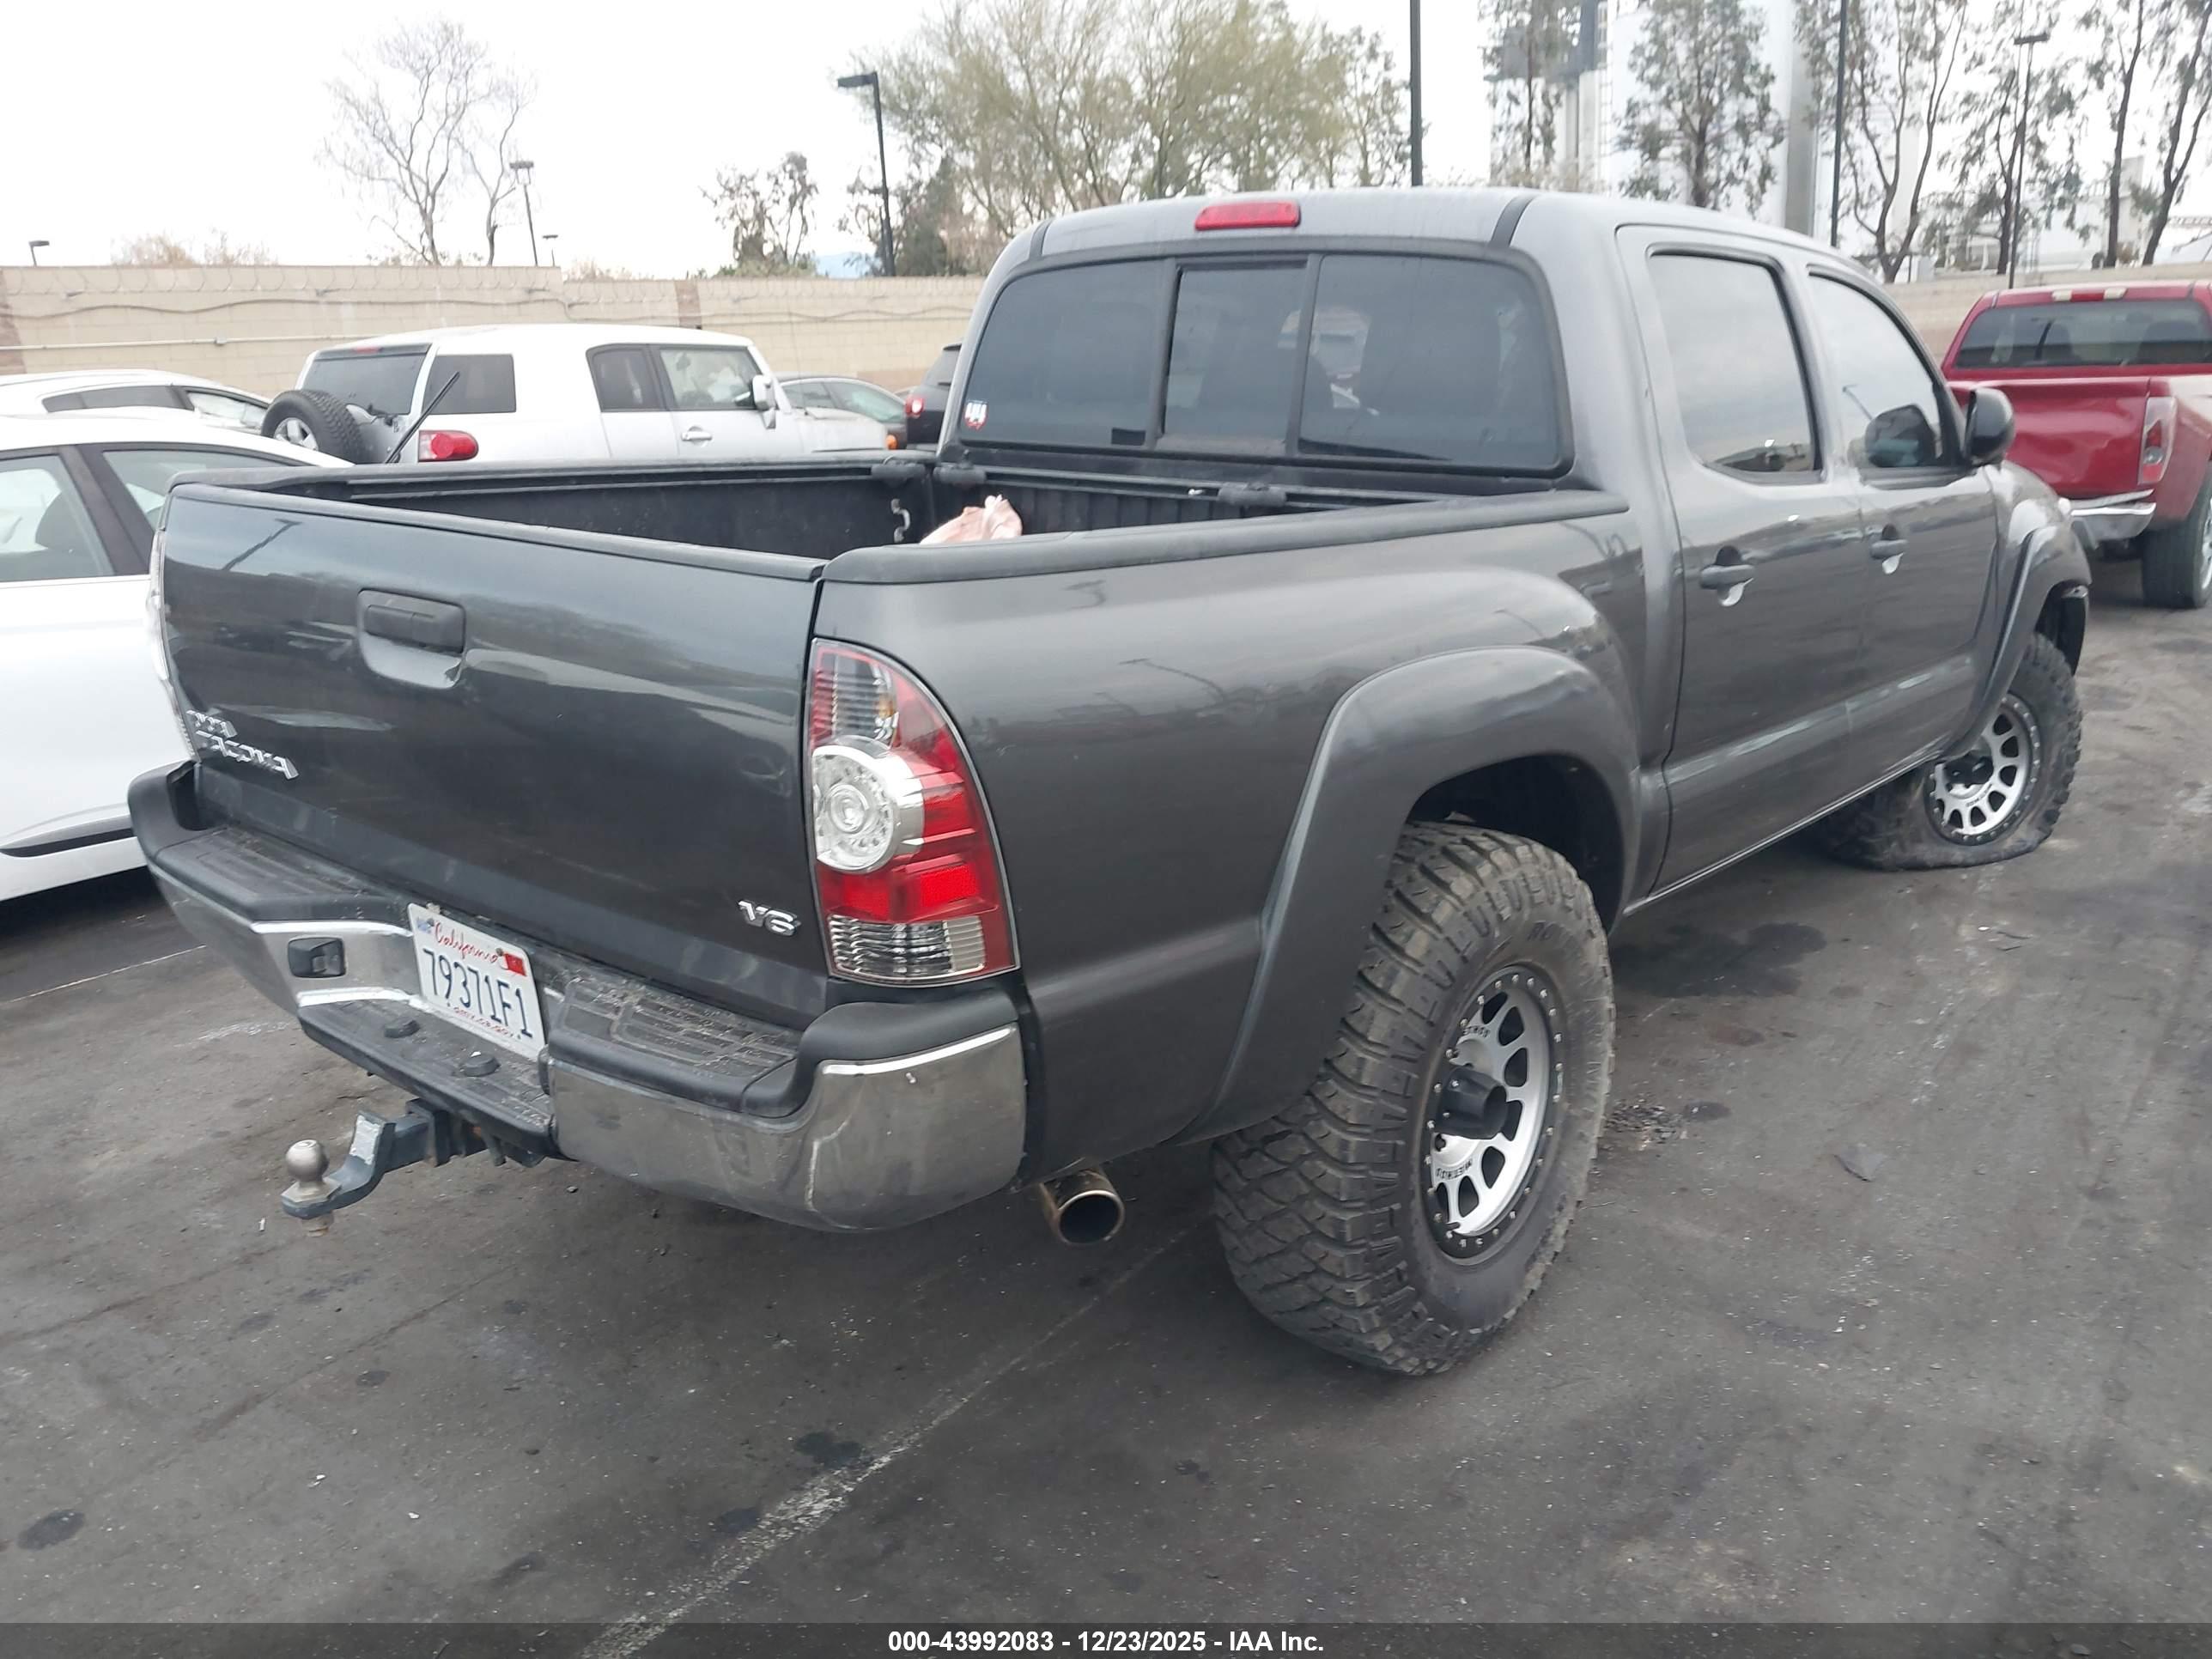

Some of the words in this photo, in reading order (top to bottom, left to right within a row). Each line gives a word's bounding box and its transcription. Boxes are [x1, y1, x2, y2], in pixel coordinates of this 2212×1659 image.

[196, 730, 299, 780] TACOMA
[738, 900, 801, 936] V6
[434, 921, 498, 963] California
[422, 948, 533, 1038] 79371F1
